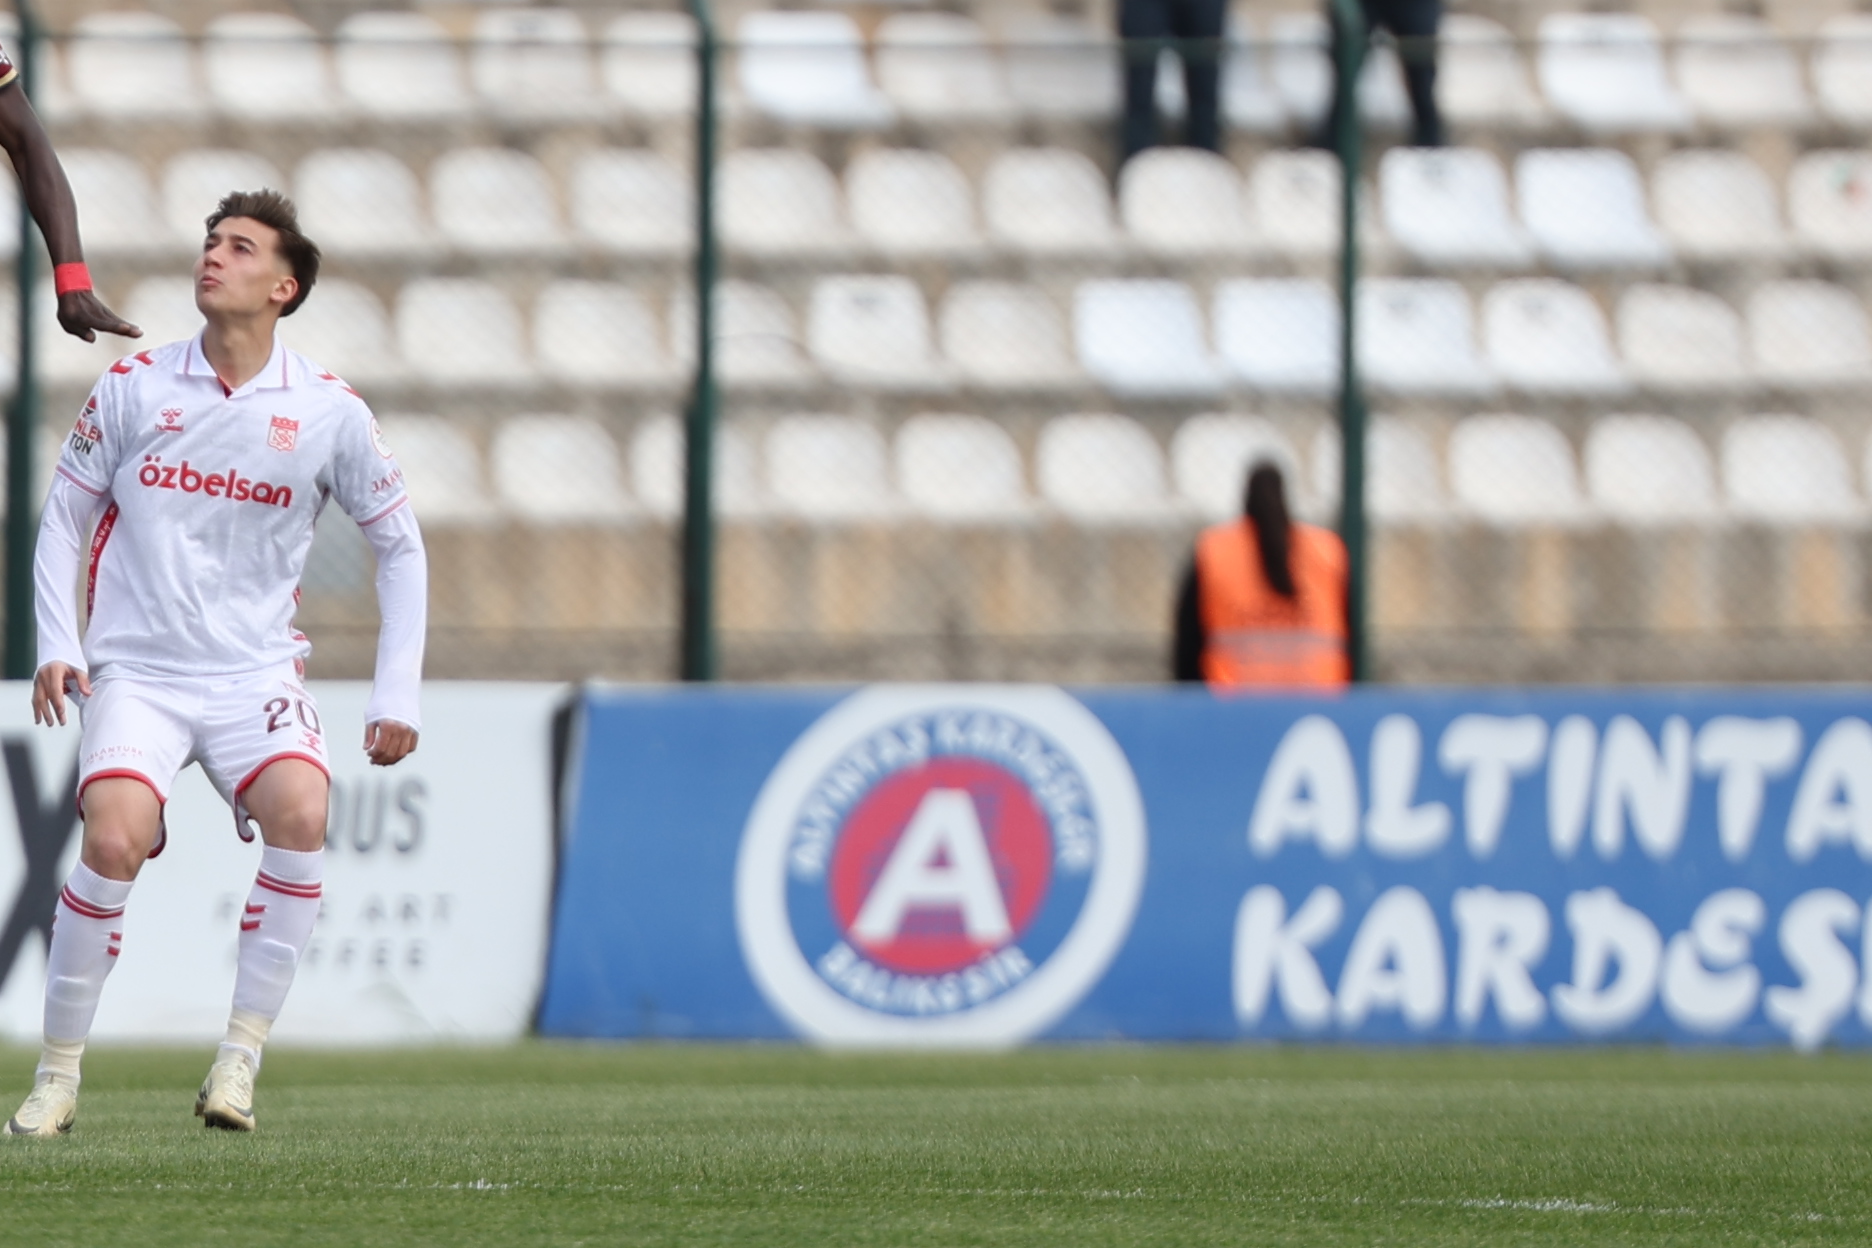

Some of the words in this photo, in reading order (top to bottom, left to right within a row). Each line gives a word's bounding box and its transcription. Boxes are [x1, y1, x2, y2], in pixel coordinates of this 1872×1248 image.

[69, 432, 95, 455] TON
[138, 454, 293, 509] özbelsan
[263, 696, 322, 735] 20
[851, 786, 1016, 946] A
[1232, 883, 1872, 1054] KARDEŞ
